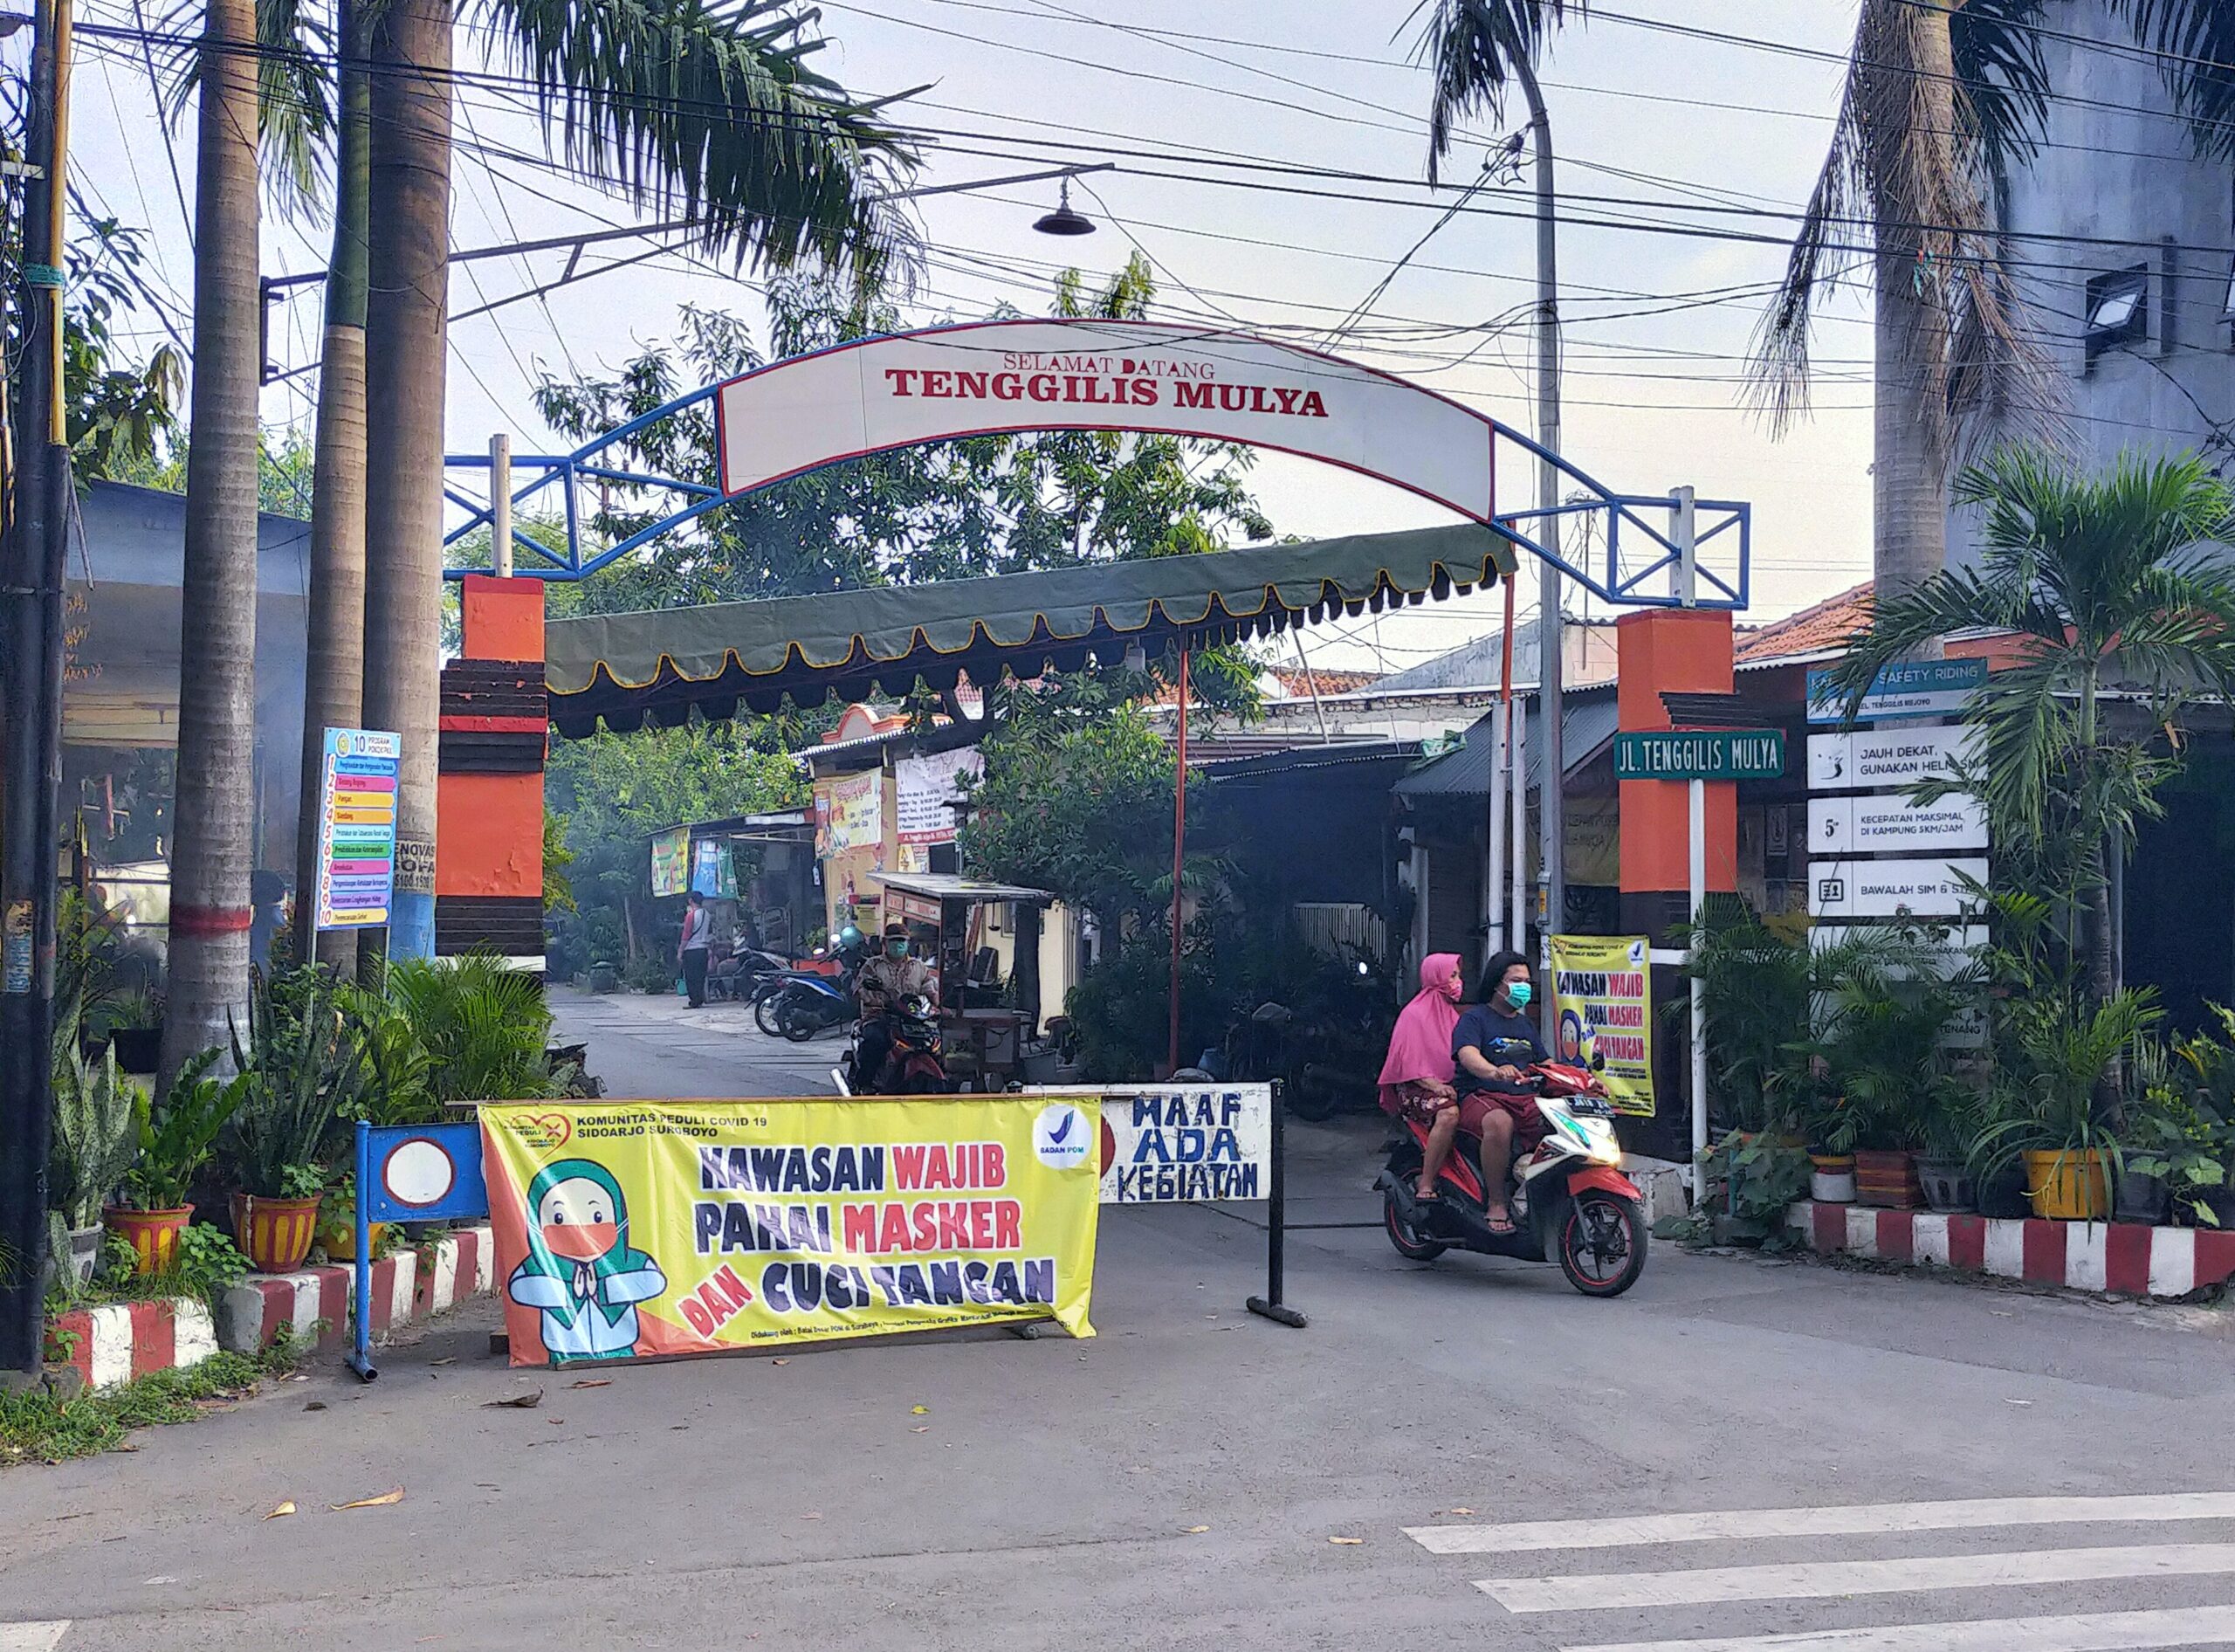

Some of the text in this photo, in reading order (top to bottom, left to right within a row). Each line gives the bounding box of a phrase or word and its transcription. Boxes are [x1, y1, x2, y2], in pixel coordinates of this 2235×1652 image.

[1003, 353, 1216, 380] SELAMAT DATANG
[884, 368, 1330, 417] TENGGILIS MULYA
[1879, 665, 1978, 685] SAFETY RIDING
[1904, 698, 1931, 706] MEJOYO
[354, 735, 366, 753] 10
[1731, 738, 1778, 770] MULYA
[1860, 748, 1893, 760] JAUH
[1860, 761, 1918, 775] GUNAKAN
[1860, 812, 1963, 824] KECEPATAN MAKSIMAL
[1861, 823, 1963, 836] DI KAMPUNG 5KM/JAM
[395, 842, 435, 857] ENOVAS
[1860, 885, 1914, 895] BAWALAH
[1917, 885, 1936, 894] SIM
[320, 910, 332, 924] 10
[1607, 973, 1643, 998] WAJIB
[577, 1112, 767, 1126] KOMUNITAS PEDULI COVID 19
[1133, 1092, 1241, 1127] MAAF
[577, 1125, 718, 1139] SIDOARJO SUROBOYO
[1132, 1128, 1241, 1163] ADA
[699, 1144, 1006, 1192] KAWASAN WAJIB
[1118, 1162, 1258, 1201] KEGIATAN
[694, 1201, 1020, 1253] PAKAI MASKER
[762, 1259, 1054, 1312] CUCI TANGAN
[678, 1264, 753, 1339] DAN
